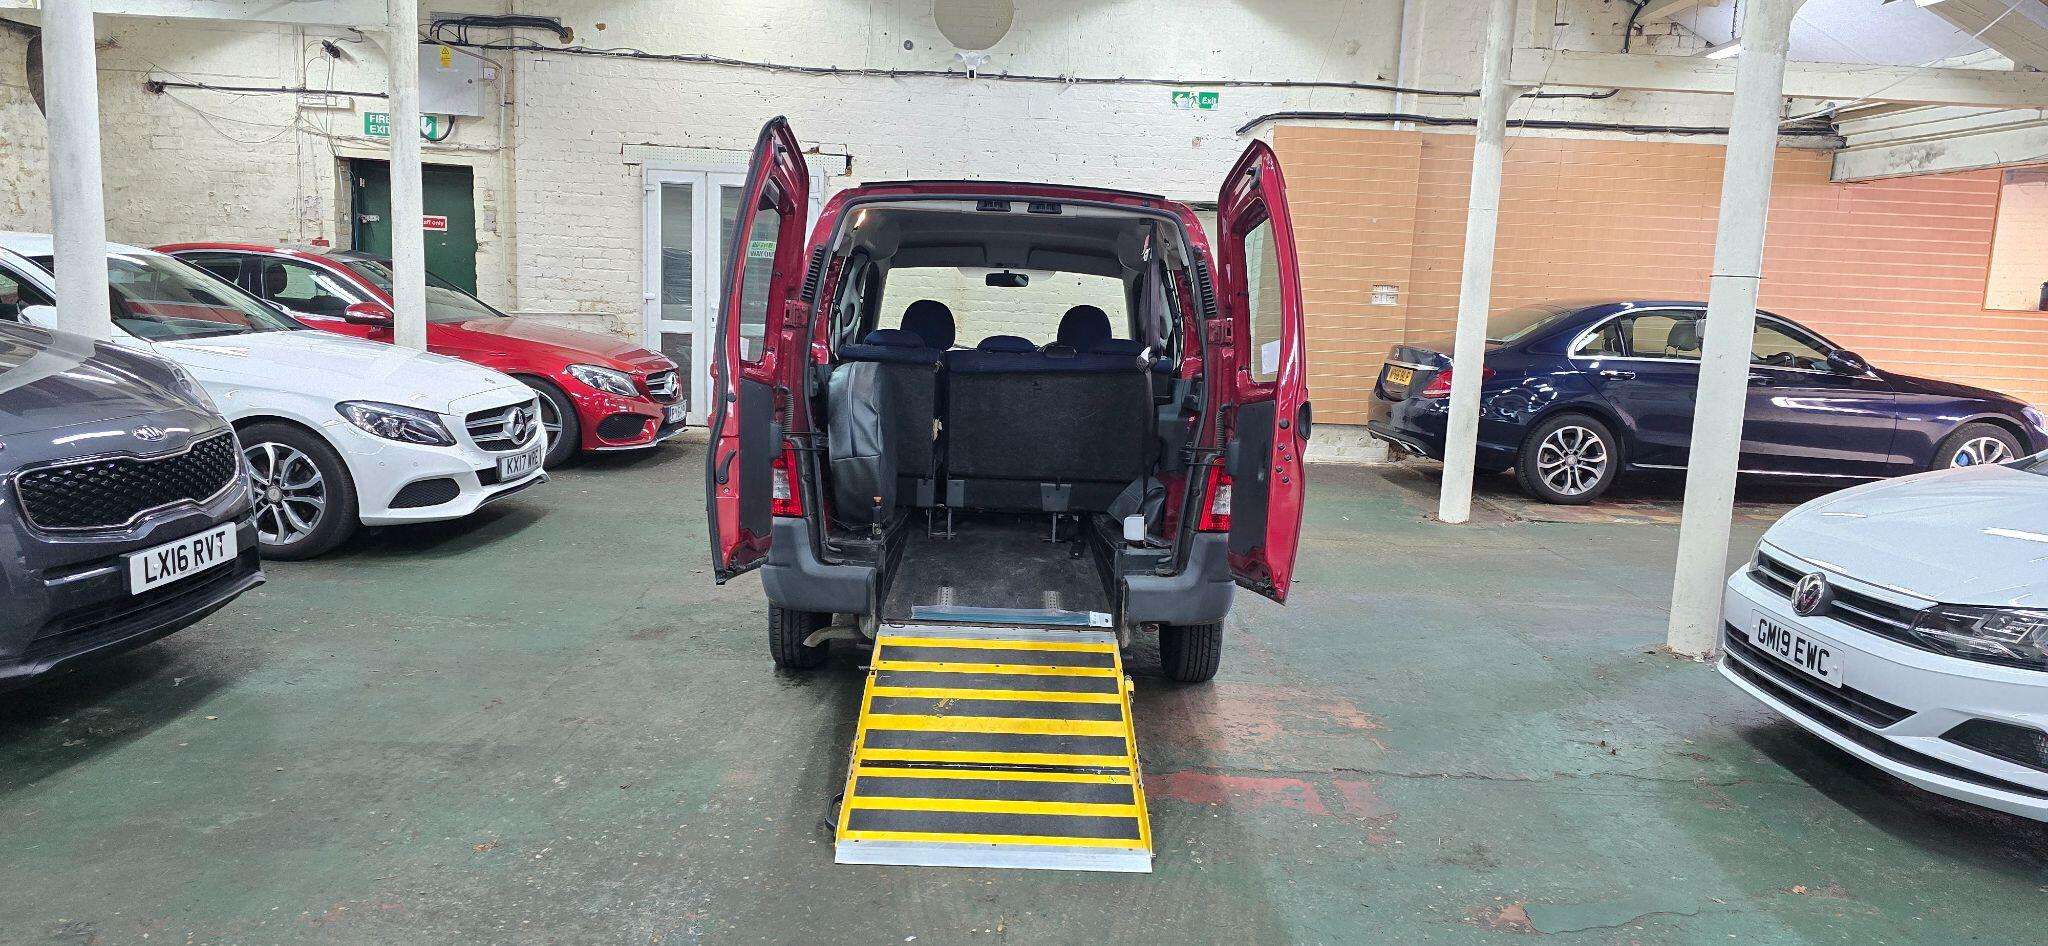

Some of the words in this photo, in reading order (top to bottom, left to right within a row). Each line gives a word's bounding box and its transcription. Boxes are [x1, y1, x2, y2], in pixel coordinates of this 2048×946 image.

[1202, 96, 1217, 105] Exit
[369, 114, 390, 124] FIRE
[506, 454, 527, 475] KX17
[144, 544, 189, 584] LX16
[193, 530, 226, 567] RVT
[1757, 618, 1791, 657] GM19
[1794, 636, 1830, 677] EWC
